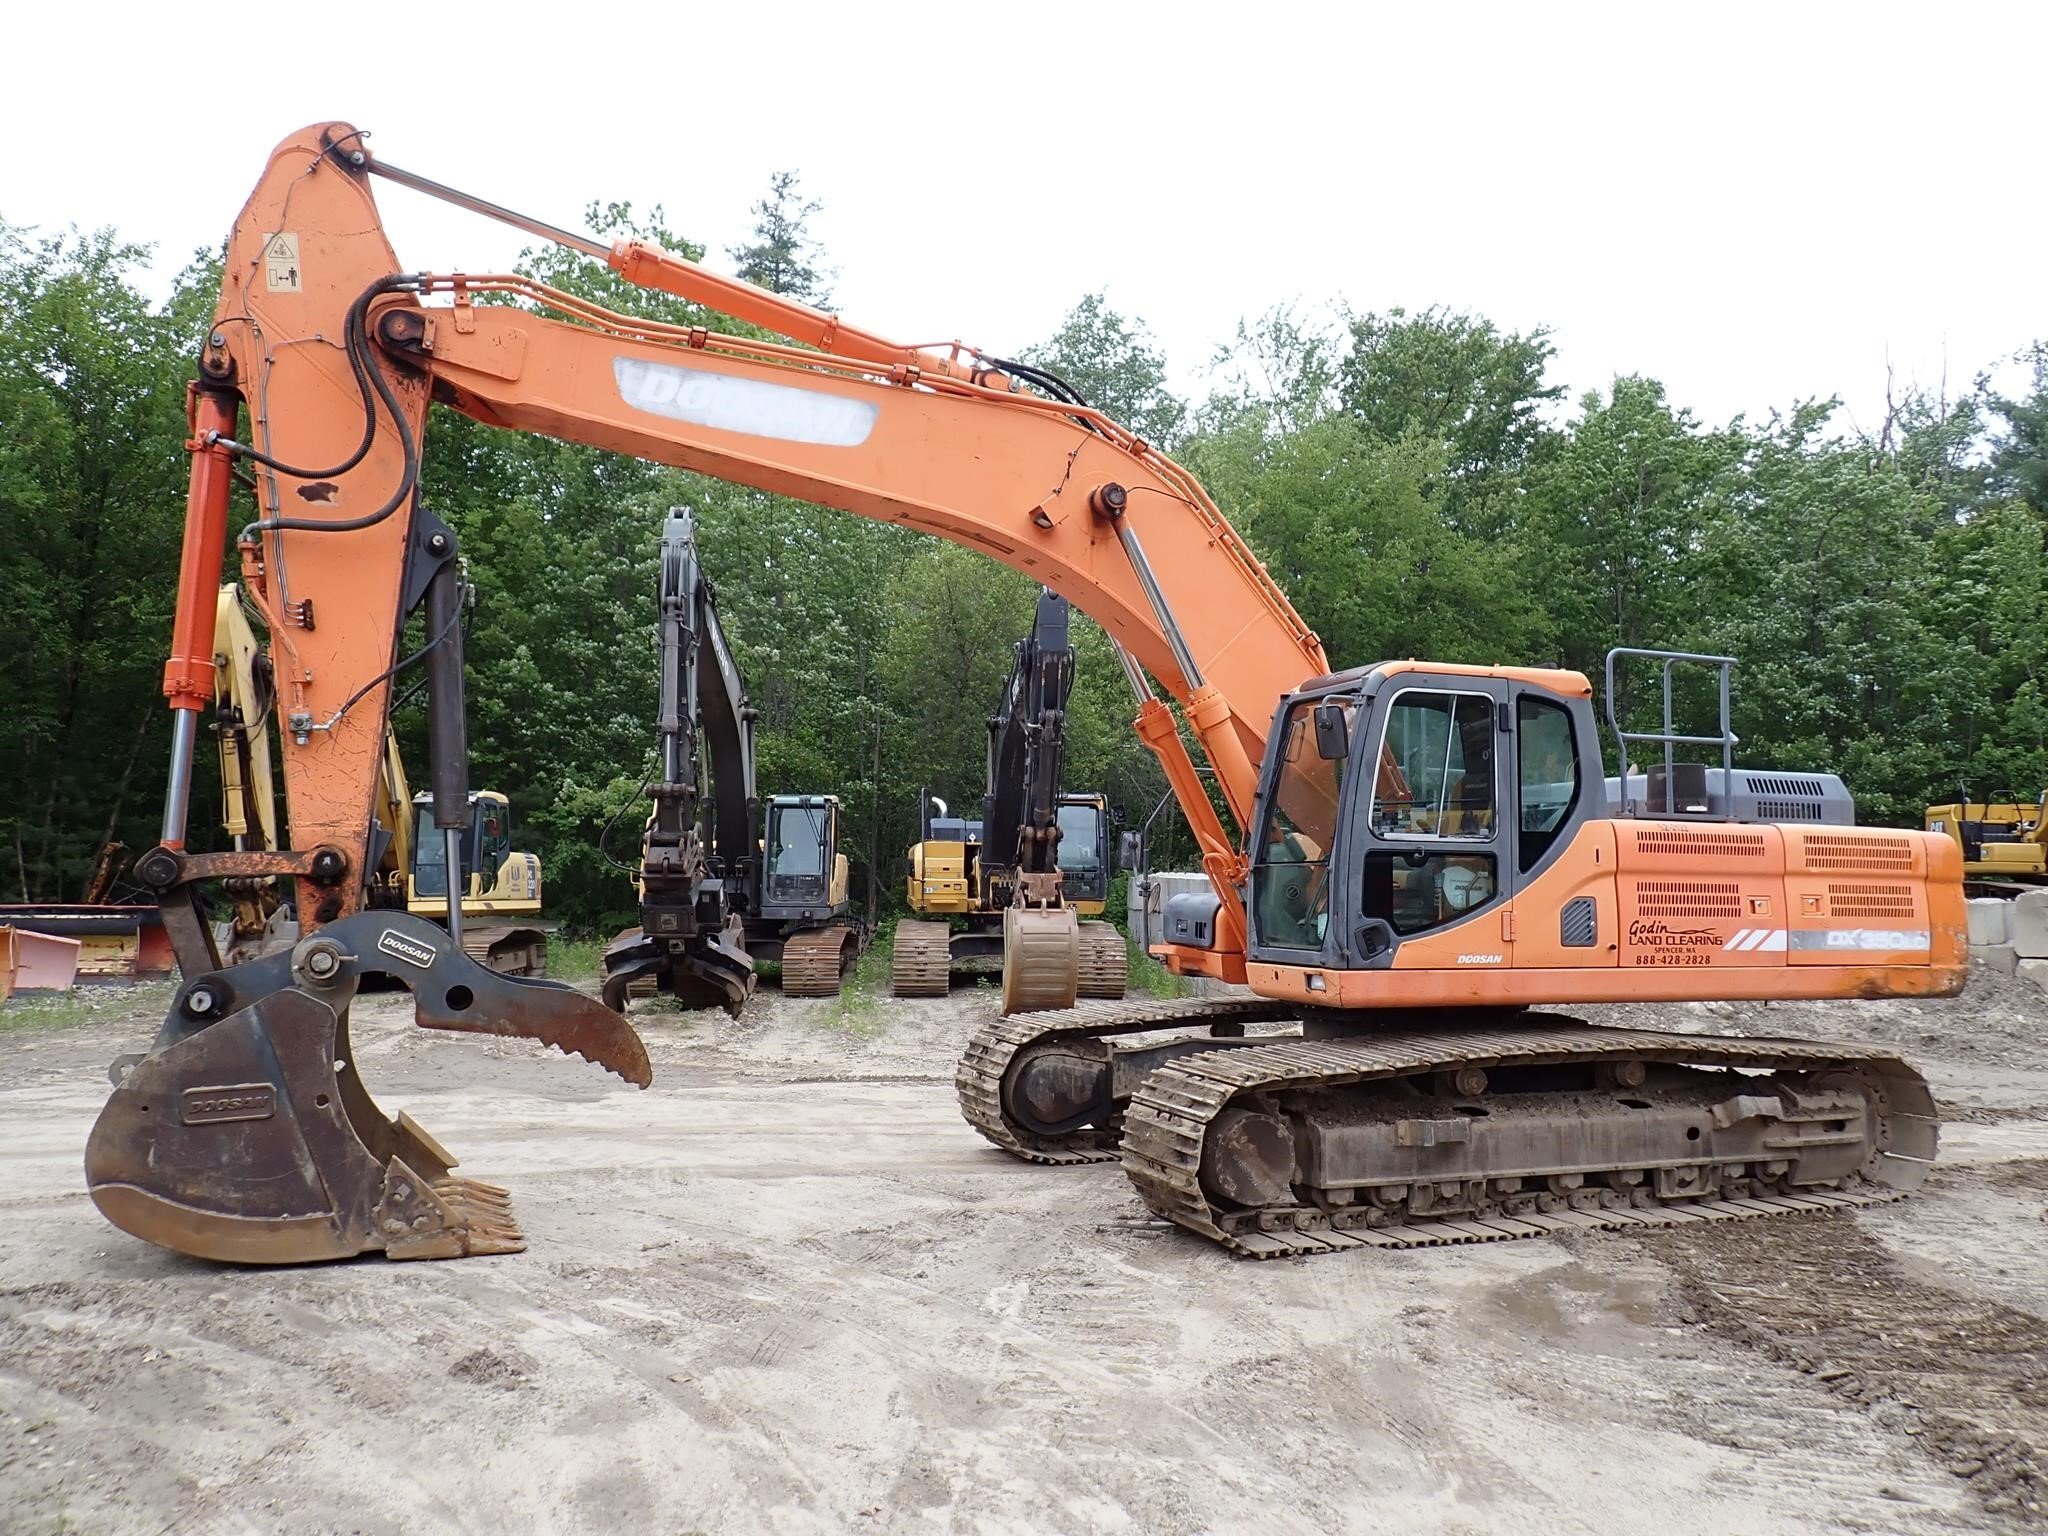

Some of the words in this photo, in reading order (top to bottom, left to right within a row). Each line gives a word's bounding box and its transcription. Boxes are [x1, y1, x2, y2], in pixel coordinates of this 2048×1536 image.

[1629, 919, 1673, 937] Godin
[1628, 935, 1662, 946] LAND
[1665, 935, 1723, 946] CLEARING
[383, 937, 431, 961] DOOSAN
[1456, 954, 1503, 964] DOOSAN
[1635, 954, 1711, 965] 888-428-2828
